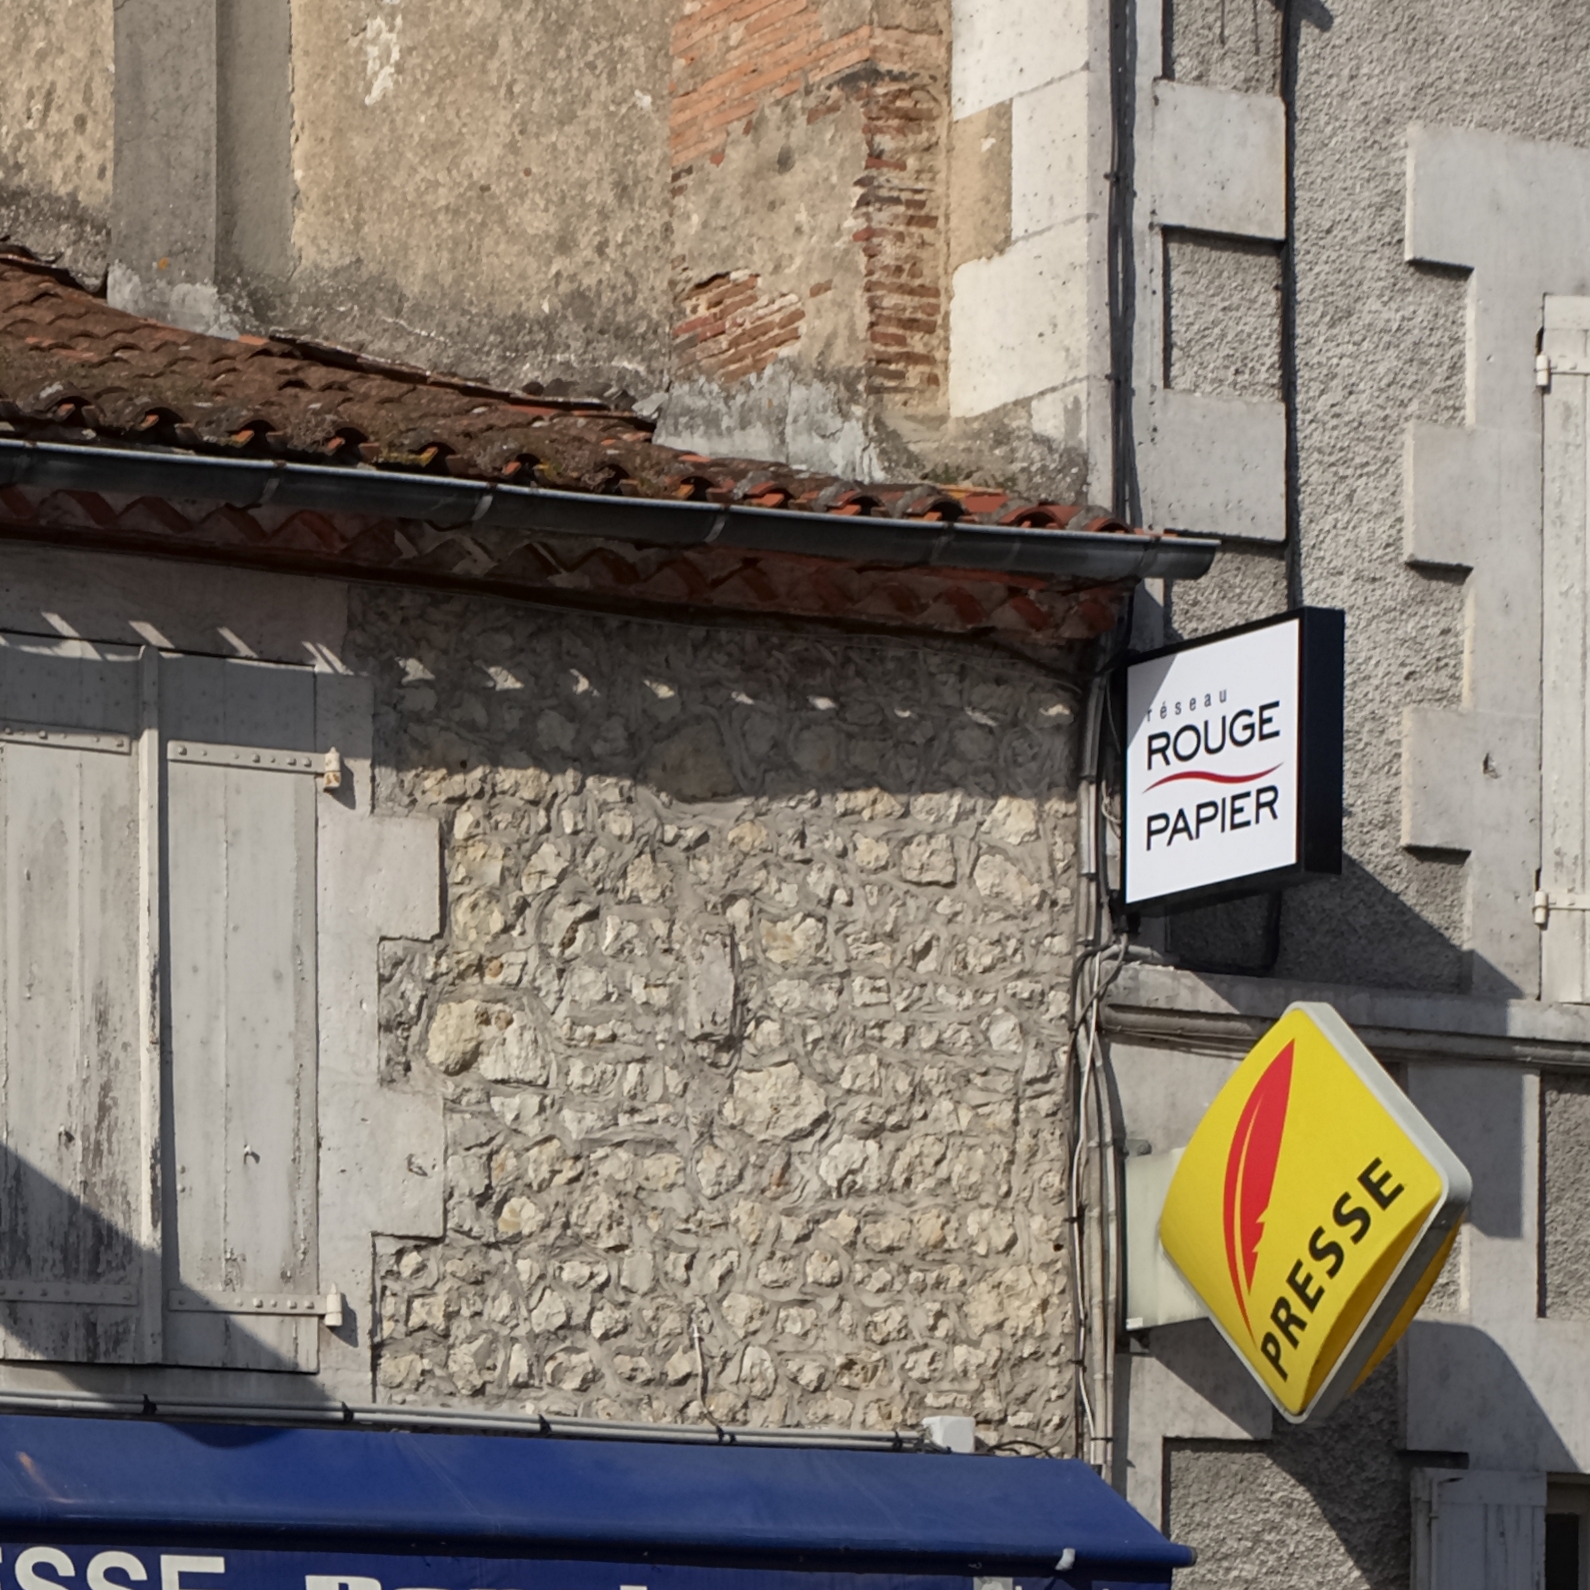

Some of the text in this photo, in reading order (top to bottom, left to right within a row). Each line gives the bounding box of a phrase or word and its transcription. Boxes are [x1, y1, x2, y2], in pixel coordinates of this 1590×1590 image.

[1147, 700, 1280, 770] ROUGE
[1146, 785, 1279, 851] PAPIER
[1260, 1157, 1405, 1382] PRESSE
